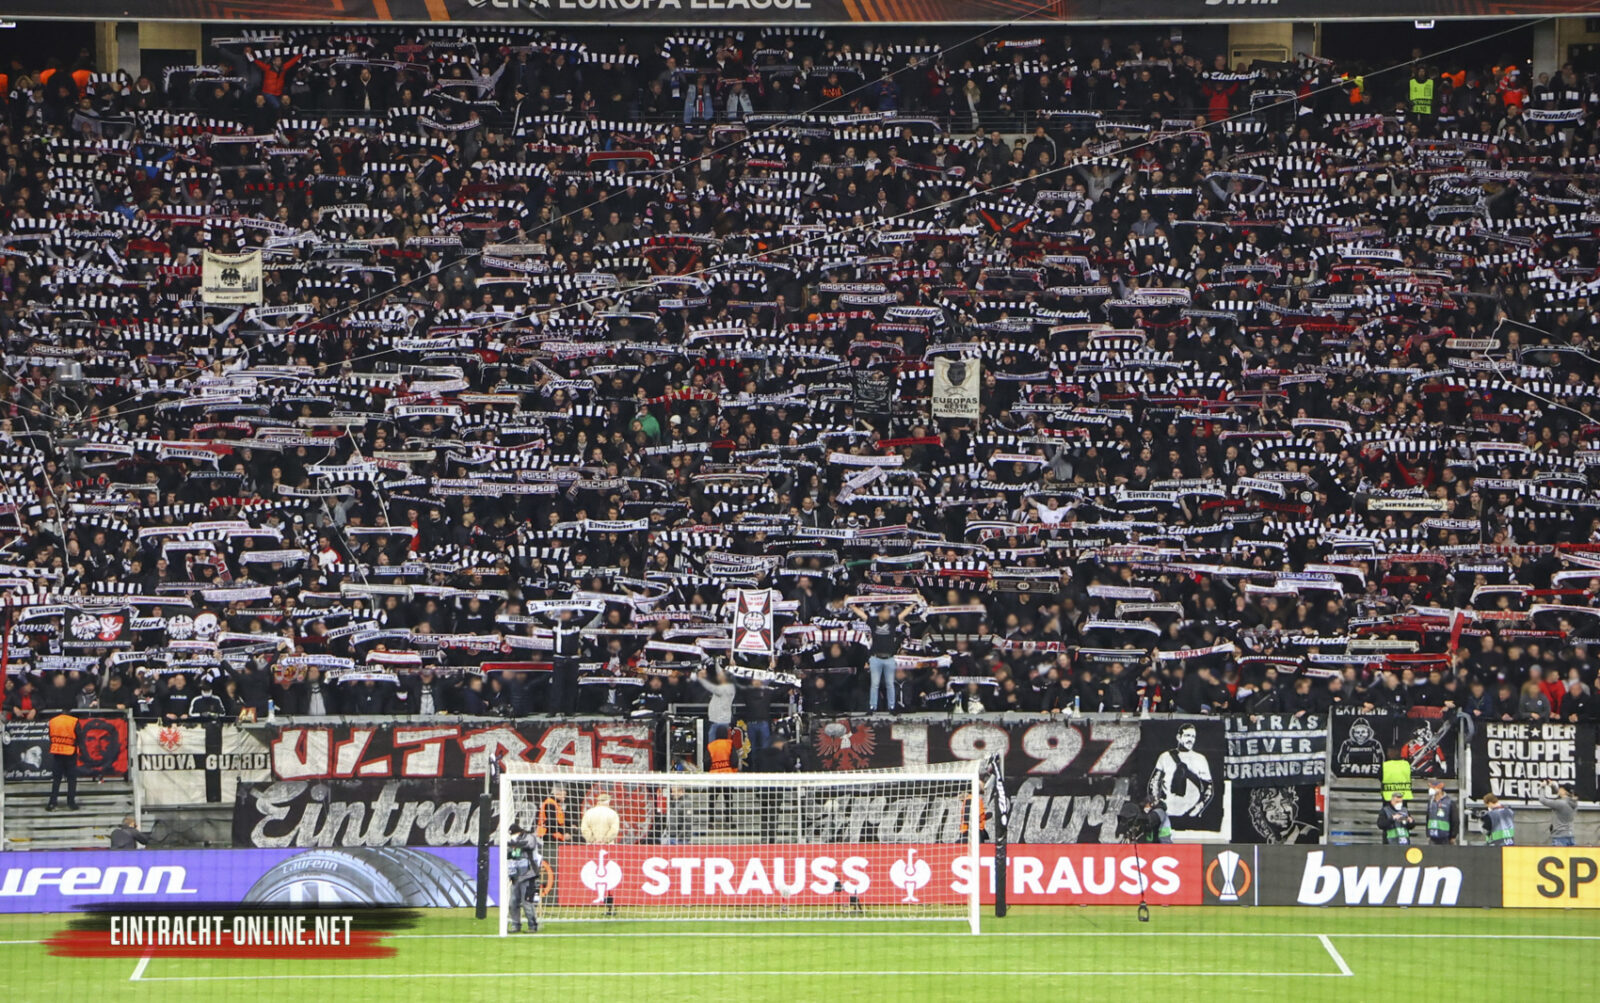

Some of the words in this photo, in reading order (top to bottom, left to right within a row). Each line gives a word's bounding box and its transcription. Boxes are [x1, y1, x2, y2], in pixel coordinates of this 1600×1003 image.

[1211, 71, 1259, 81] Eintracht
[1351, 249, 1394, 258] Eintracht
[254, 306, 298, 317] Eintracht
[1036, 308, 1089, 319] Eintracht
[401, 340, 453, 349] Frankfurt
[206, 387, 251, 397] Eintracht
[933, 396, 979, 405] EUROPAS
[405, 406, 449, 415] Eintracht
[1055, 410, 1108, 424] Eintracht
[167, 448, 216, 460] Eintracht
[384, 478, 426, 488] Eintracht
[980, 479, 1033, 491] Eintracht
[1240, 480, 1279, 492] intracht
[1126, 491, 1171, 500] Eintracht
[738, 524, 783, 532] Eintracht
[801, 527, 846, 538] Eintracht
[1167, 523, 1225, 536] Eintracht
[712, 562, 765, 573] Frankfurt
[1459, 563, 1504, 573] Eintracht
[328, 624, 367, 637] intracht
[1293, 634, 1348, 646] Eintracht
[1486, 723, 1529, 739] EHRE
[1541, 723, 1575, 739] DER
[273, 724, 654, 778] ULTRAS
[890, 723, 1141, 775] 1997
[1228, 739, 1312, 756] NEVER
[1486, 740, 1576, 762] GRUPPE
[140, 754, 196, 771] NUOVA
[1487, 761, 1576, 780] STADION
[641, 857, 871, 896] STRAUSS
[950, 856, 1181, 895] STRAUSS
[1297, 847, 1463, 905] bwin
